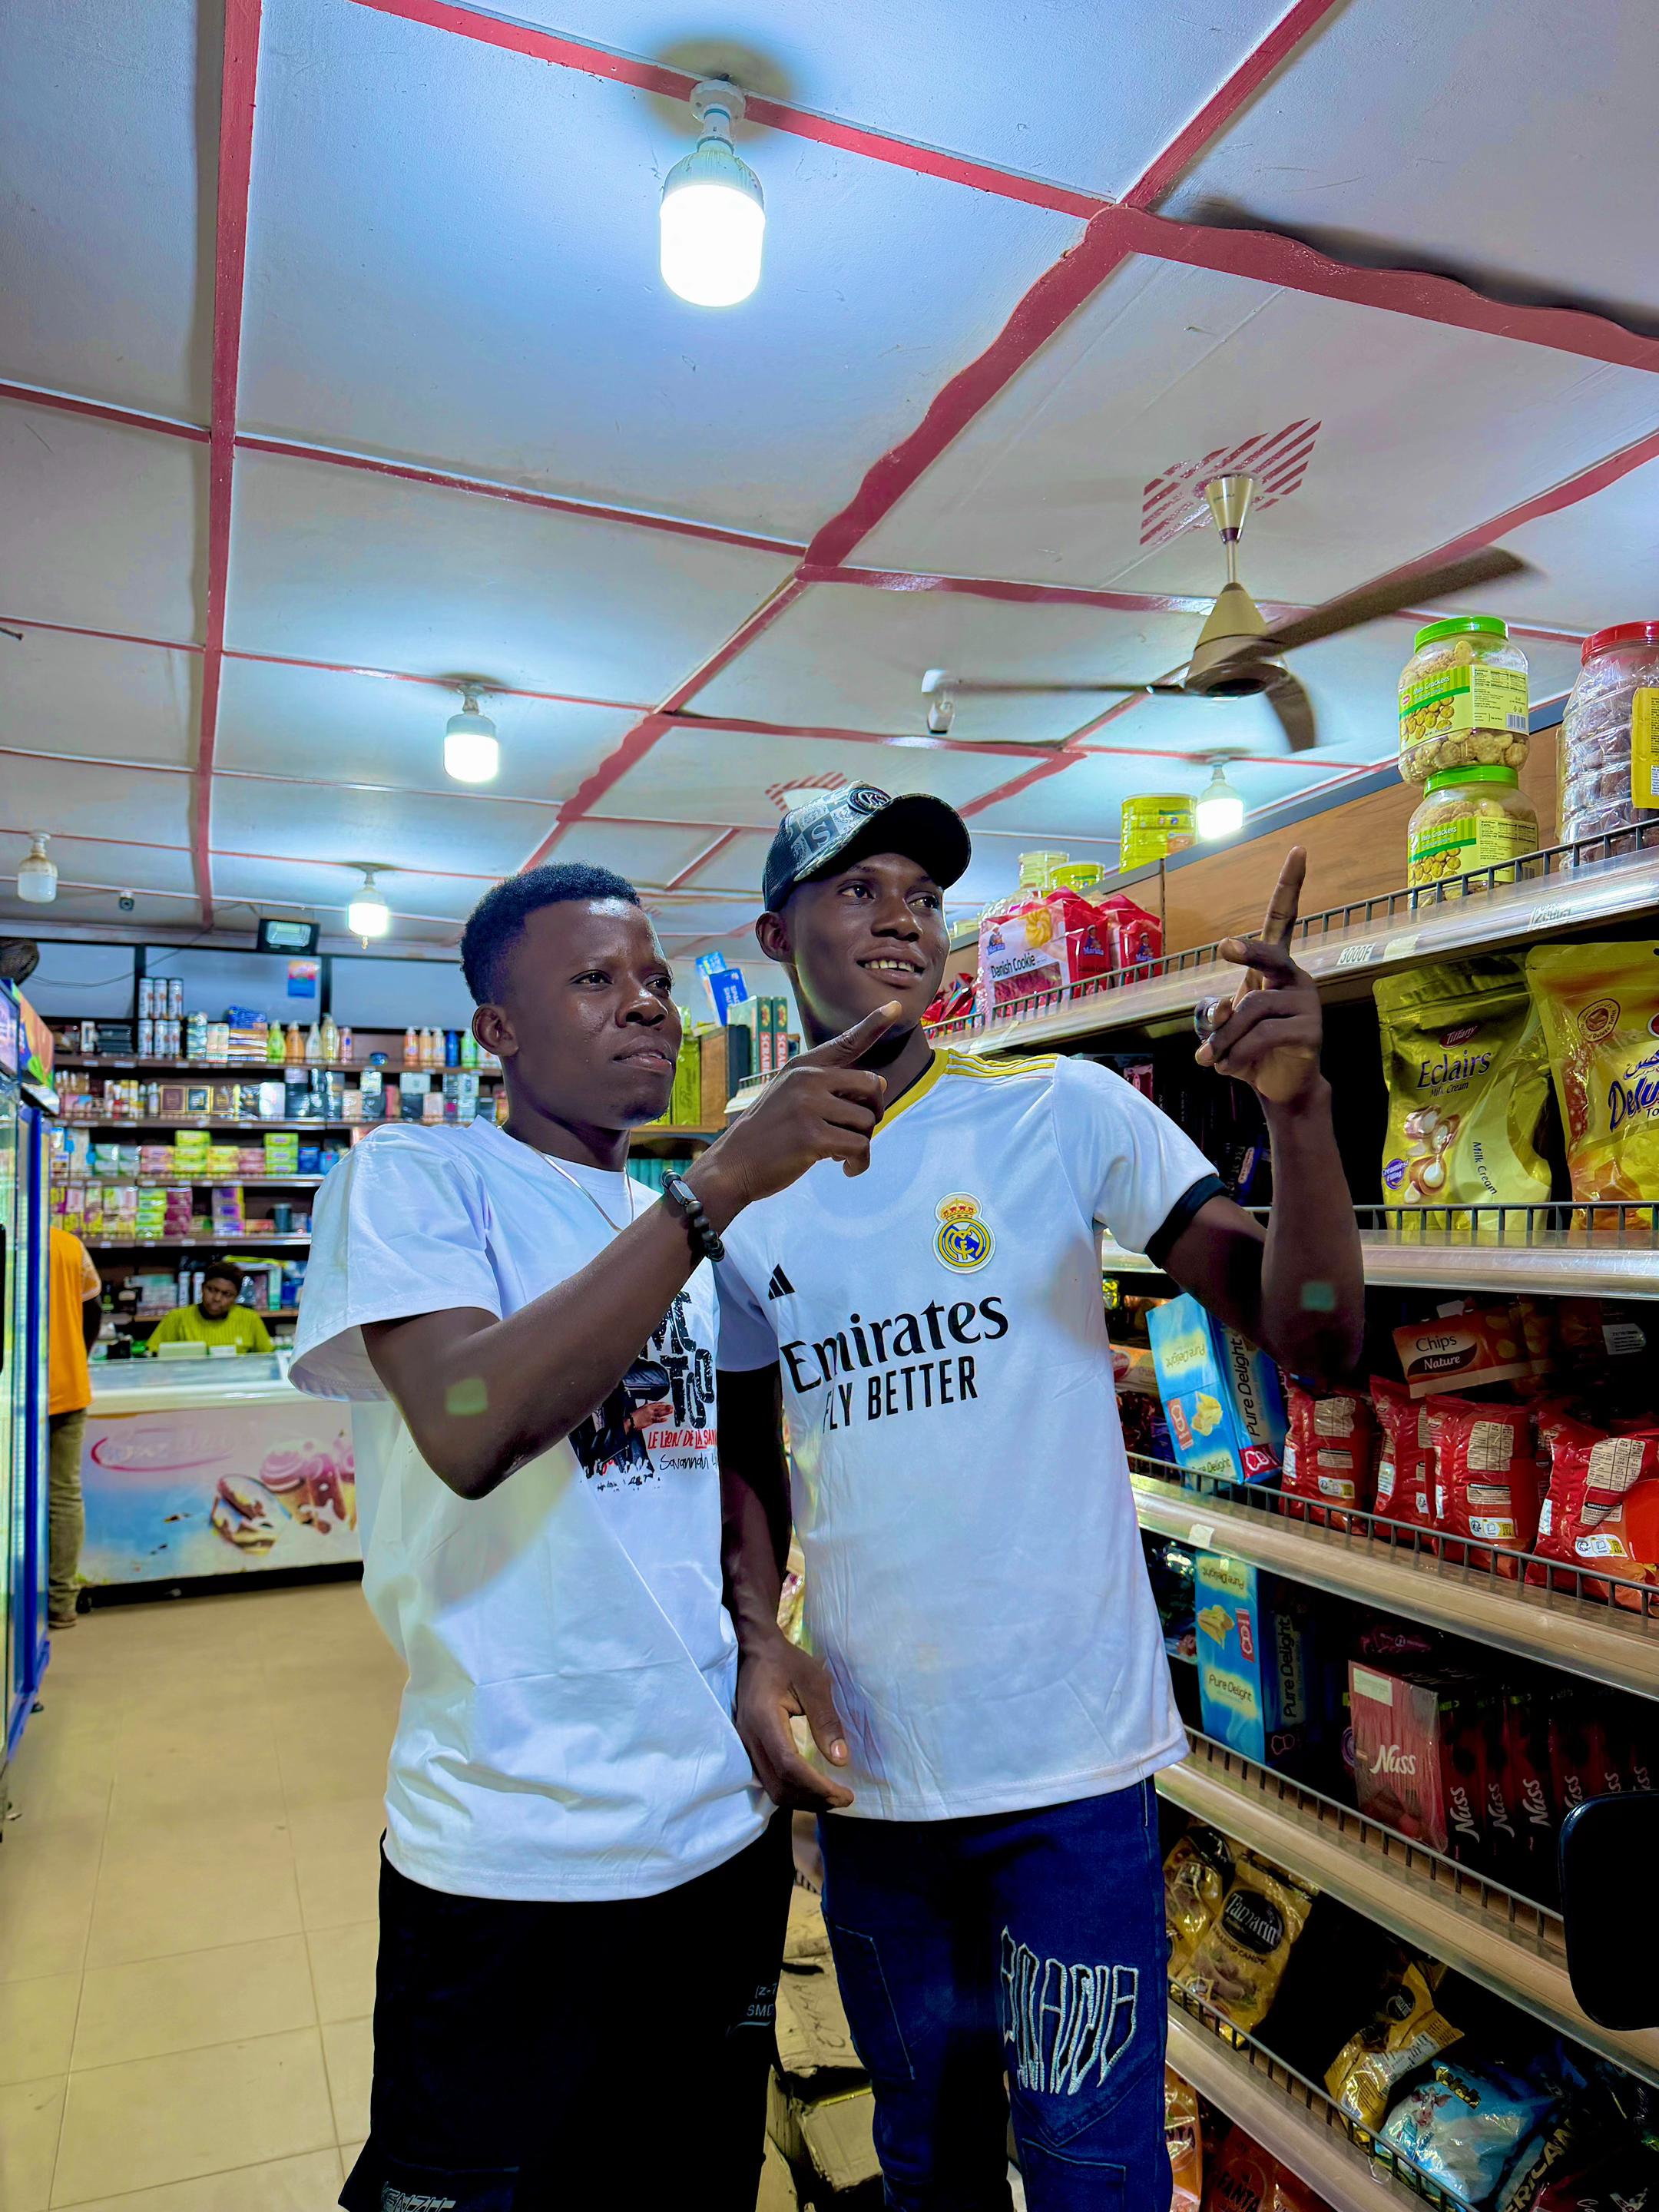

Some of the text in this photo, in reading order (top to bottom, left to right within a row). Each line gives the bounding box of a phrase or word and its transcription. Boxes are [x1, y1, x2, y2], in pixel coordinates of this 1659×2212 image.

[991, 953, 1036, 979] Danish Cookie
[1339, 945, 1373, 964] 3000F
[1416, 1049, 1492, 1089] Eclairs
[1432, 1082, 1469, 1097] Milk Cream
[1472, 1141, 1497, 1195] Milk Cream
[780, 1296, 1008, 1394] Emirates
[1416, 1333, 1457, 1353] Chips
[1423, 1354, 1460, 1371] Nature
[868, 1356, 978, 1420] BETTER
[1231, 1338, 1260, 1437] Pure Delight
[647, 1431, 658, 1449] LE
[683, 1430, 694, 1447] DE
[694, 1429, 707, 1449] LA
[660, 1452, 709, 1470] Savannah
[1278, 1614, 1297, 1718] Pure Delight
[1209, 1674, 1253, 1702] Pure Delight
[1369, 1744, 1416, 1776] Nuss
[1522, 1778, 1552, 1828] Nuss
[1565, 1775, 1585, 1809] uss
[1449, 1786, 1480, 1843] Nuss
[1488, 1783, 1515, 1839] Nuss
